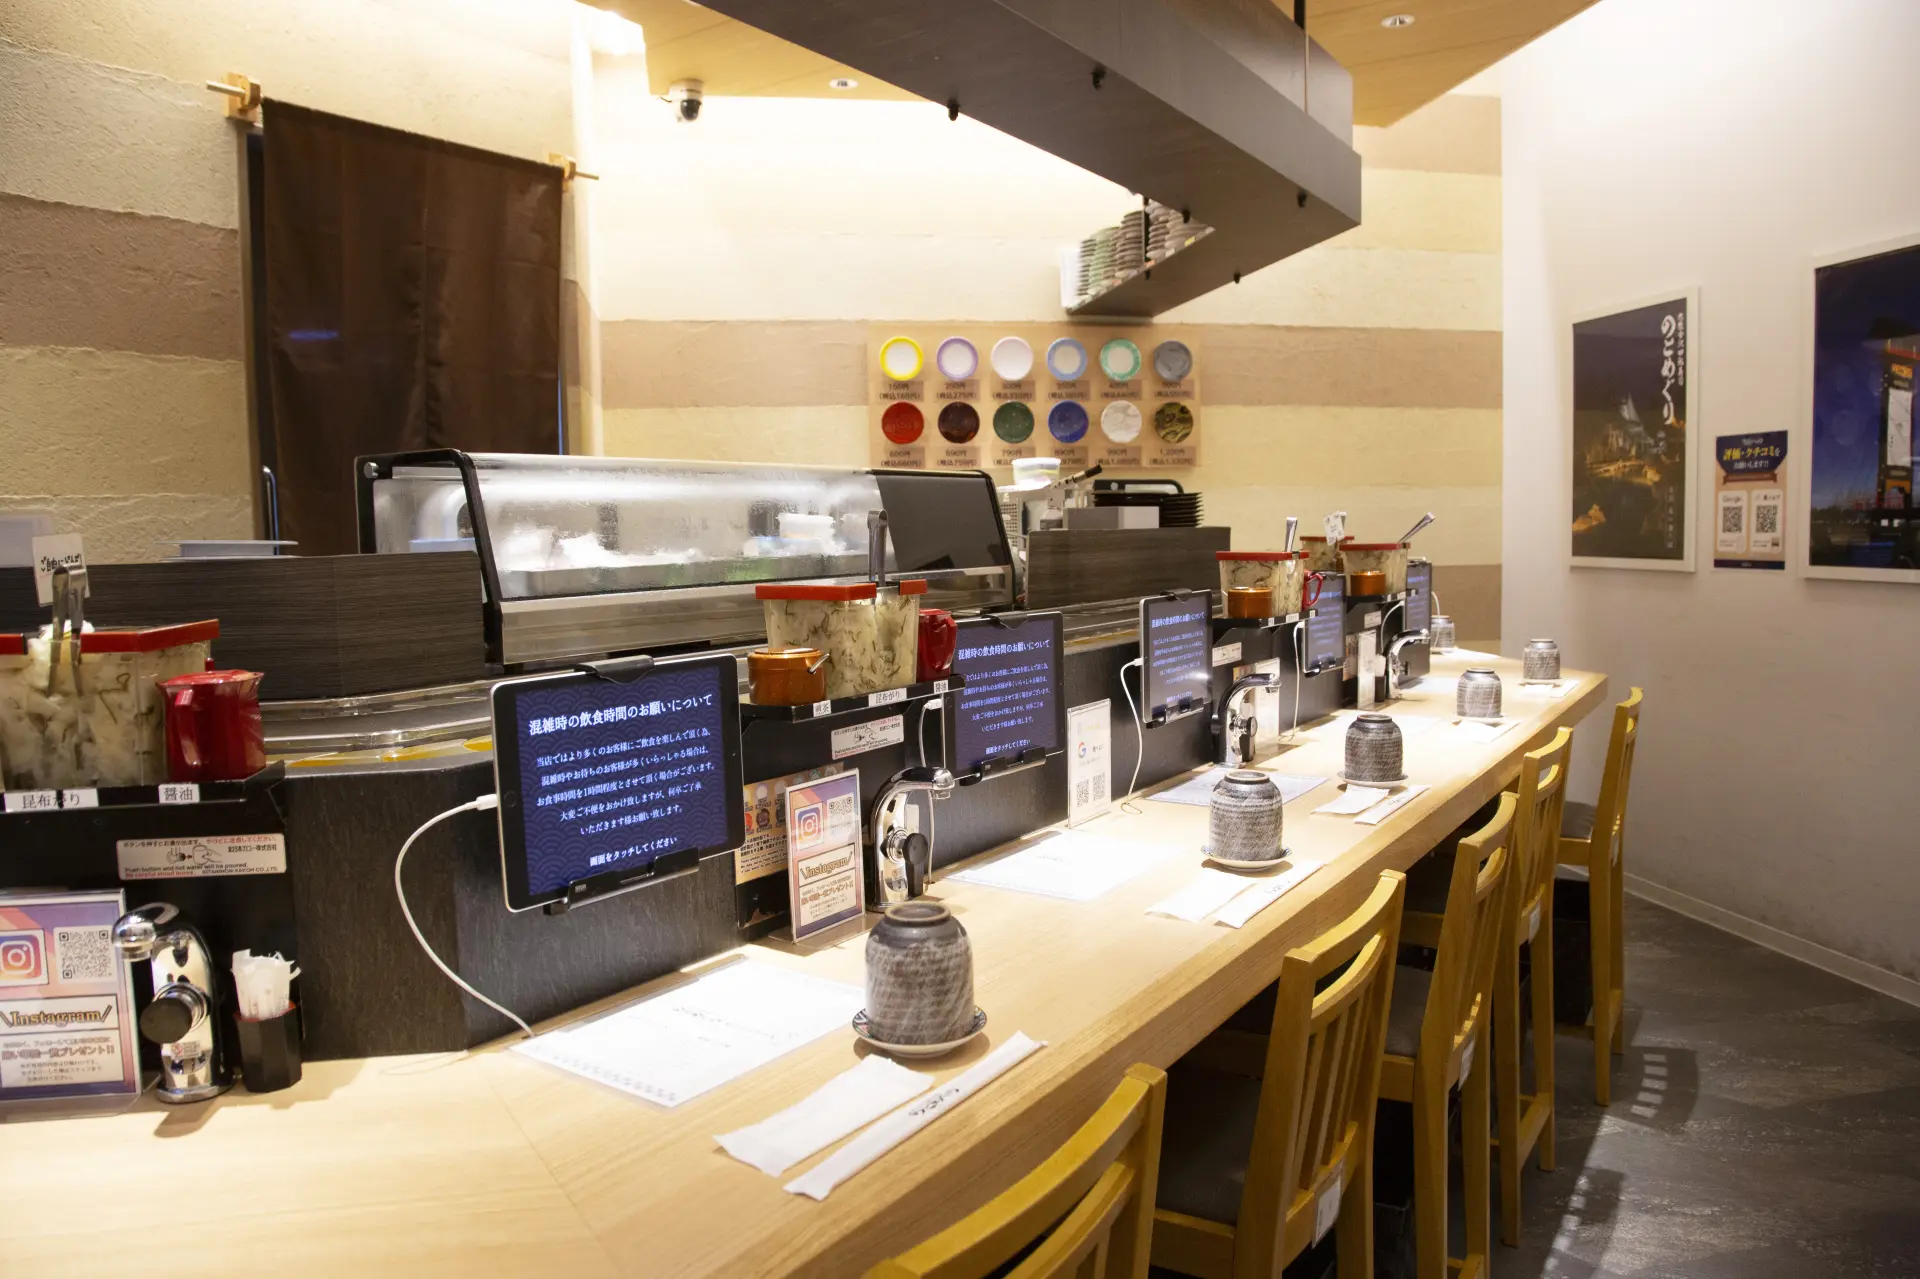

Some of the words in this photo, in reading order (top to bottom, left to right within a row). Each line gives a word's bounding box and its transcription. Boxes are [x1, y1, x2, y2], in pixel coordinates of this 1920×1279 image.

[875, 691, 900, 704] 昆布がり
[528, 693, 712, 736] 混雑時の飲食時間のお願いについて
[164, 785, 193, 801] 醤油
[806, 857, 848, 877] Instagram
[9, 1010, 102, 1028] Instagram
